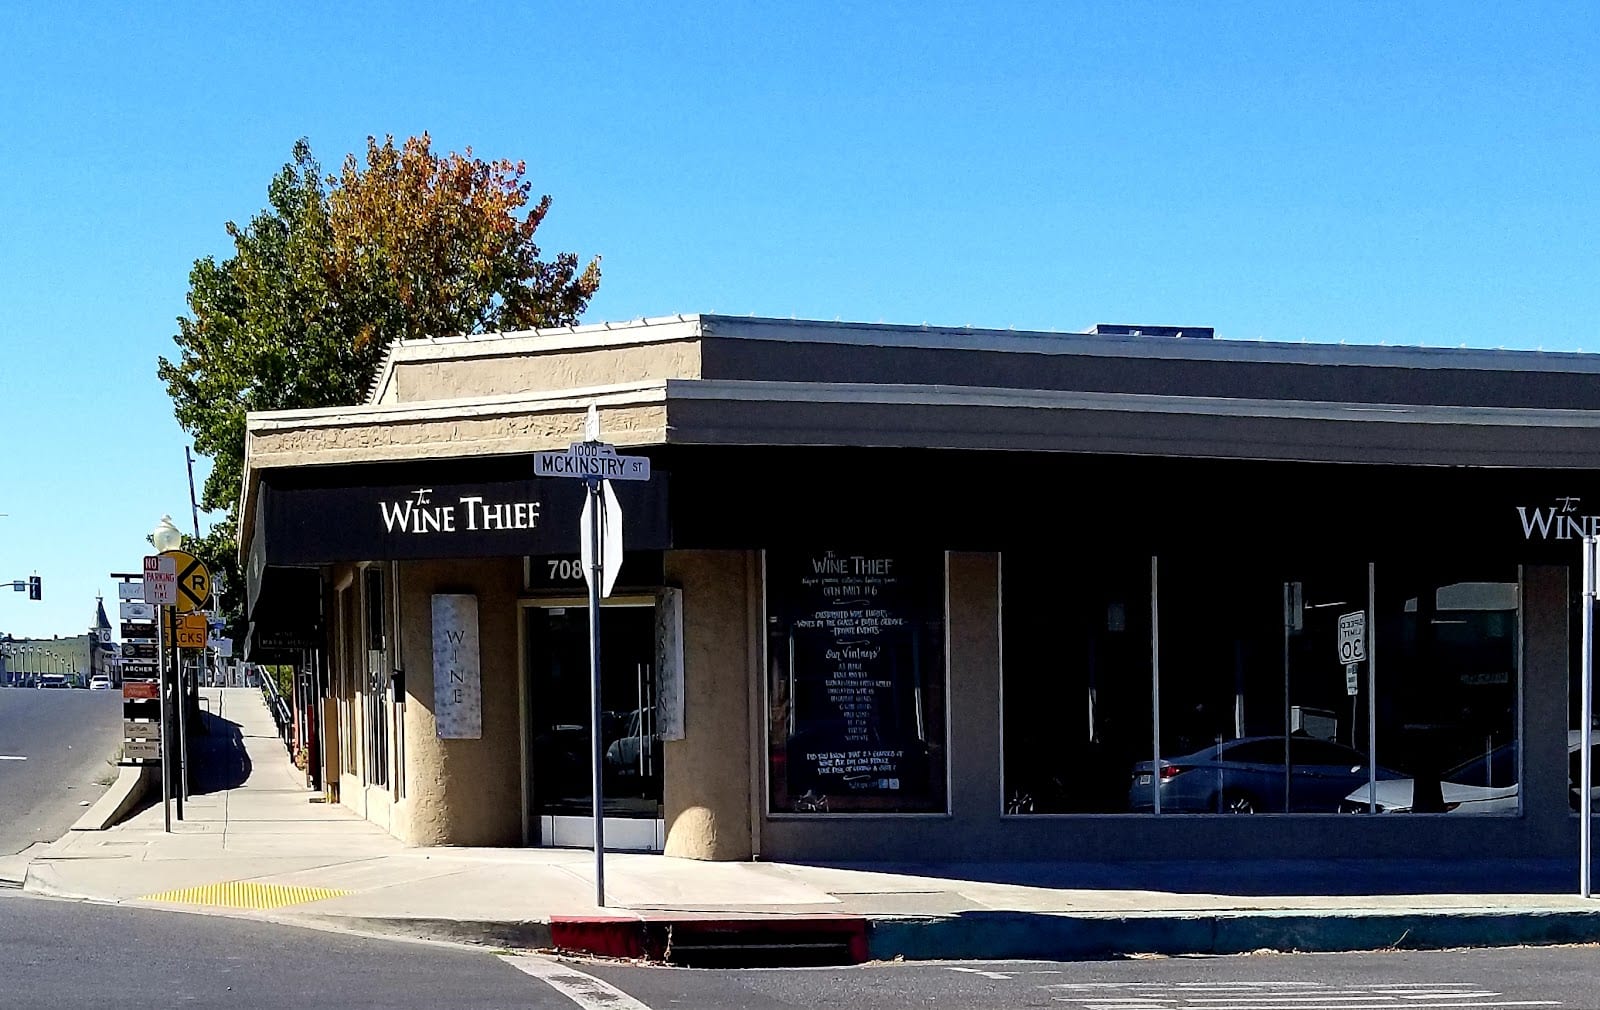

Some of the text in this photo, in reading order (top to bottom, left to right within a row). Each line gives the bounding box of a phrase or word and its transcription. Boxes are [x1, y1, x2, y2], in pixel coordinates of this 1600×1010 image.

[575, 446, 598, 457] 1000
[542, 455, 643, 475] MCKINSTRY ST
[410, 488, 433, 506] The
[1555, 496, 1581, 513] The
[378, 497, 541, 534] WINE THIEF
[145, 557, 158, 570] NO
[547, 559, 583, 580] 708
[812, 555, 894, 575] WINE THIEF
[146, 573, 175, 582] PARKING
[192, 575, 206, 591] R
[154, 583, 166, 591] ANY
[125, 665, 153, 673] ARCHER
[446, 630, 465, 704] WINE
